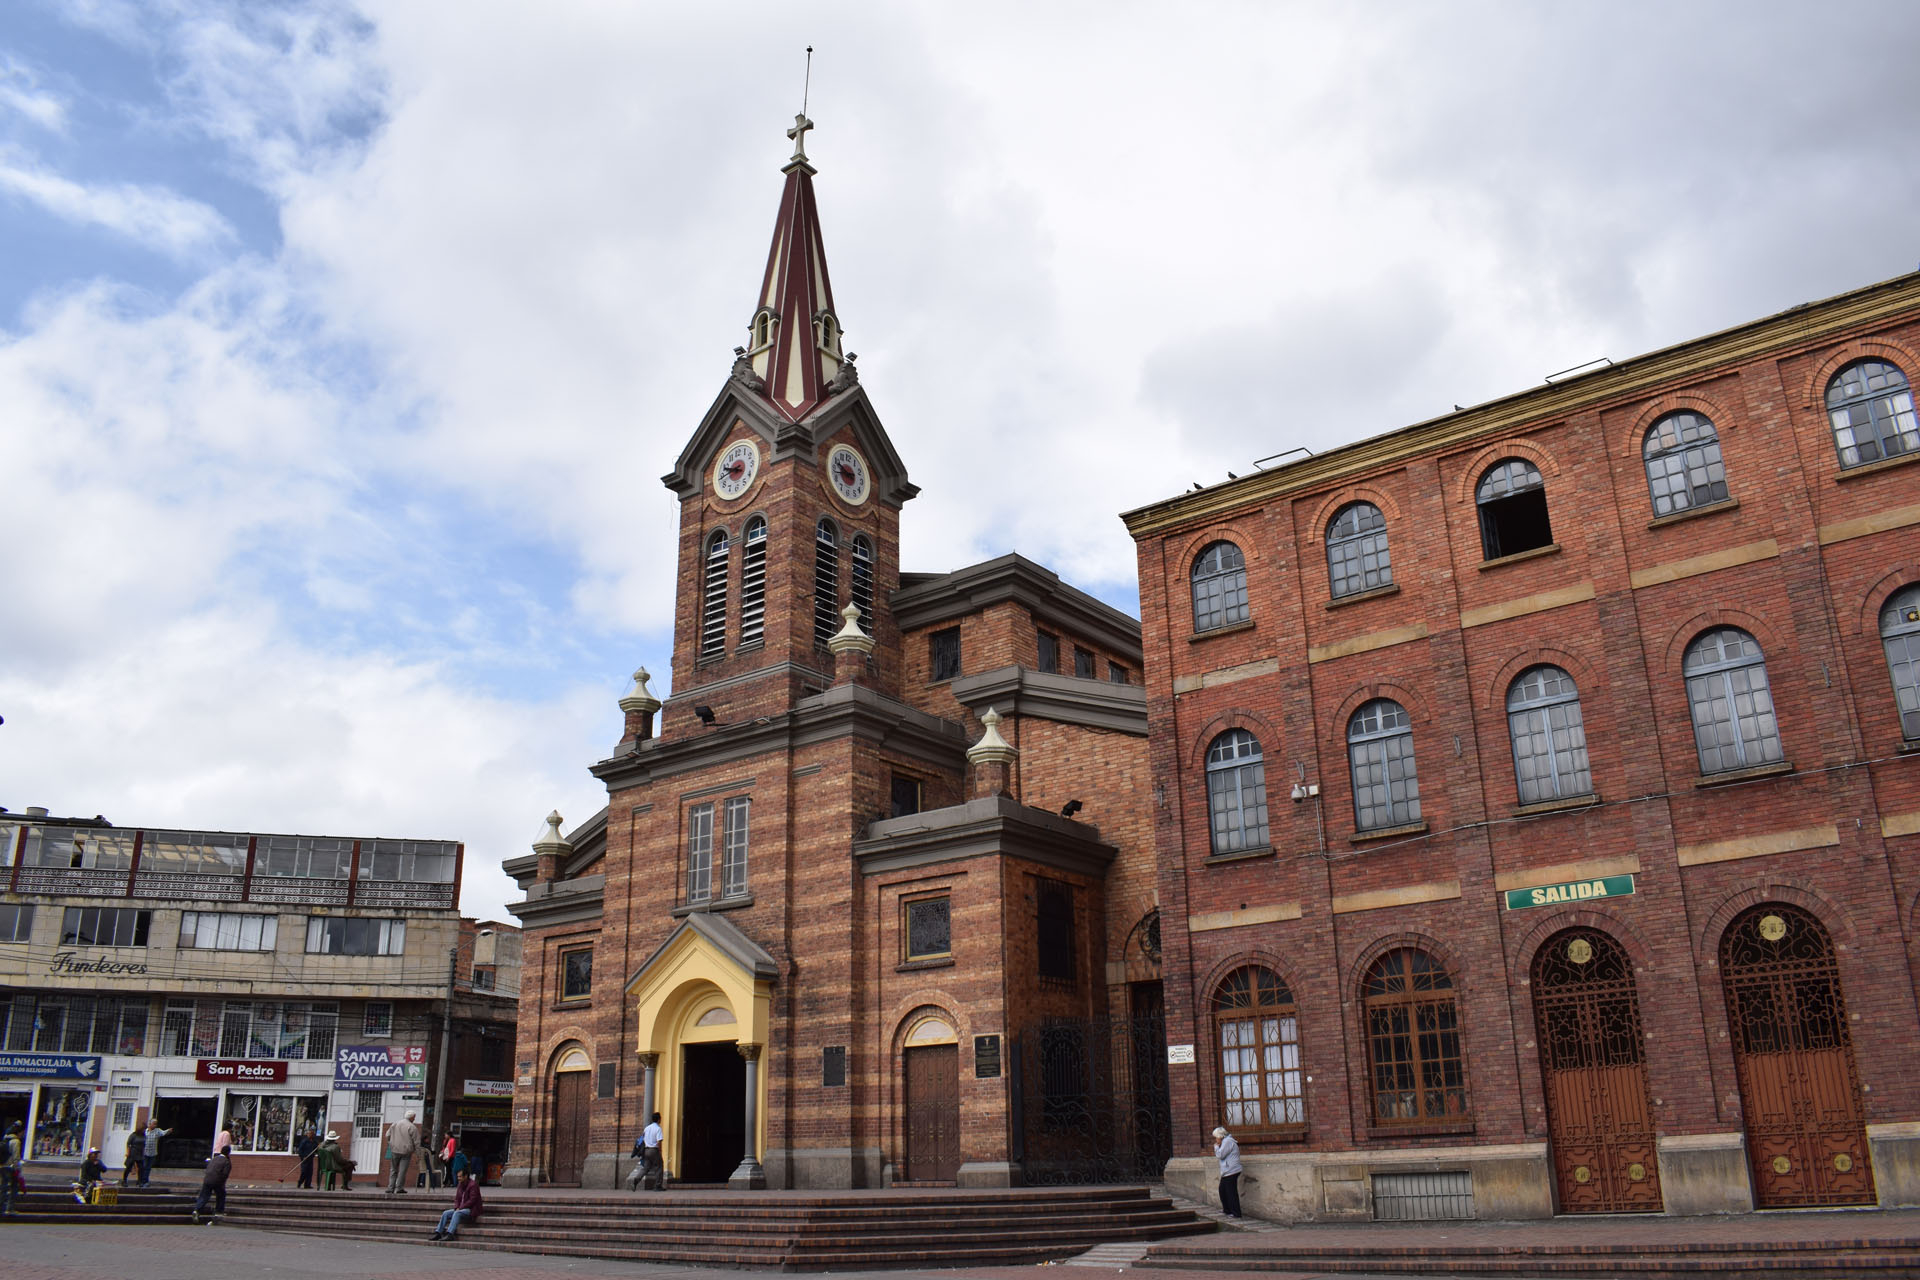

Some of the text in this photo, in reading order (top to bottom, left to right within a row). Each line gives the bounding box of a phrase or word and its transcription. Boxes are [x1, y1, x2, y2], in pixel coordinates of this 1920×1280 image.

[846, 453, 851, 462] 12
[1531, 880, 1607, 904] SALIDA
[50, 951, 147, 975] Fundecres
[339, 1049, 388, 1062] SANTA
[13, 1057, 72, 1068] INMACULADA
[207, 1062, 274, 1076] San Pedro
[490, 1088, 513, 1096] Rogelio
